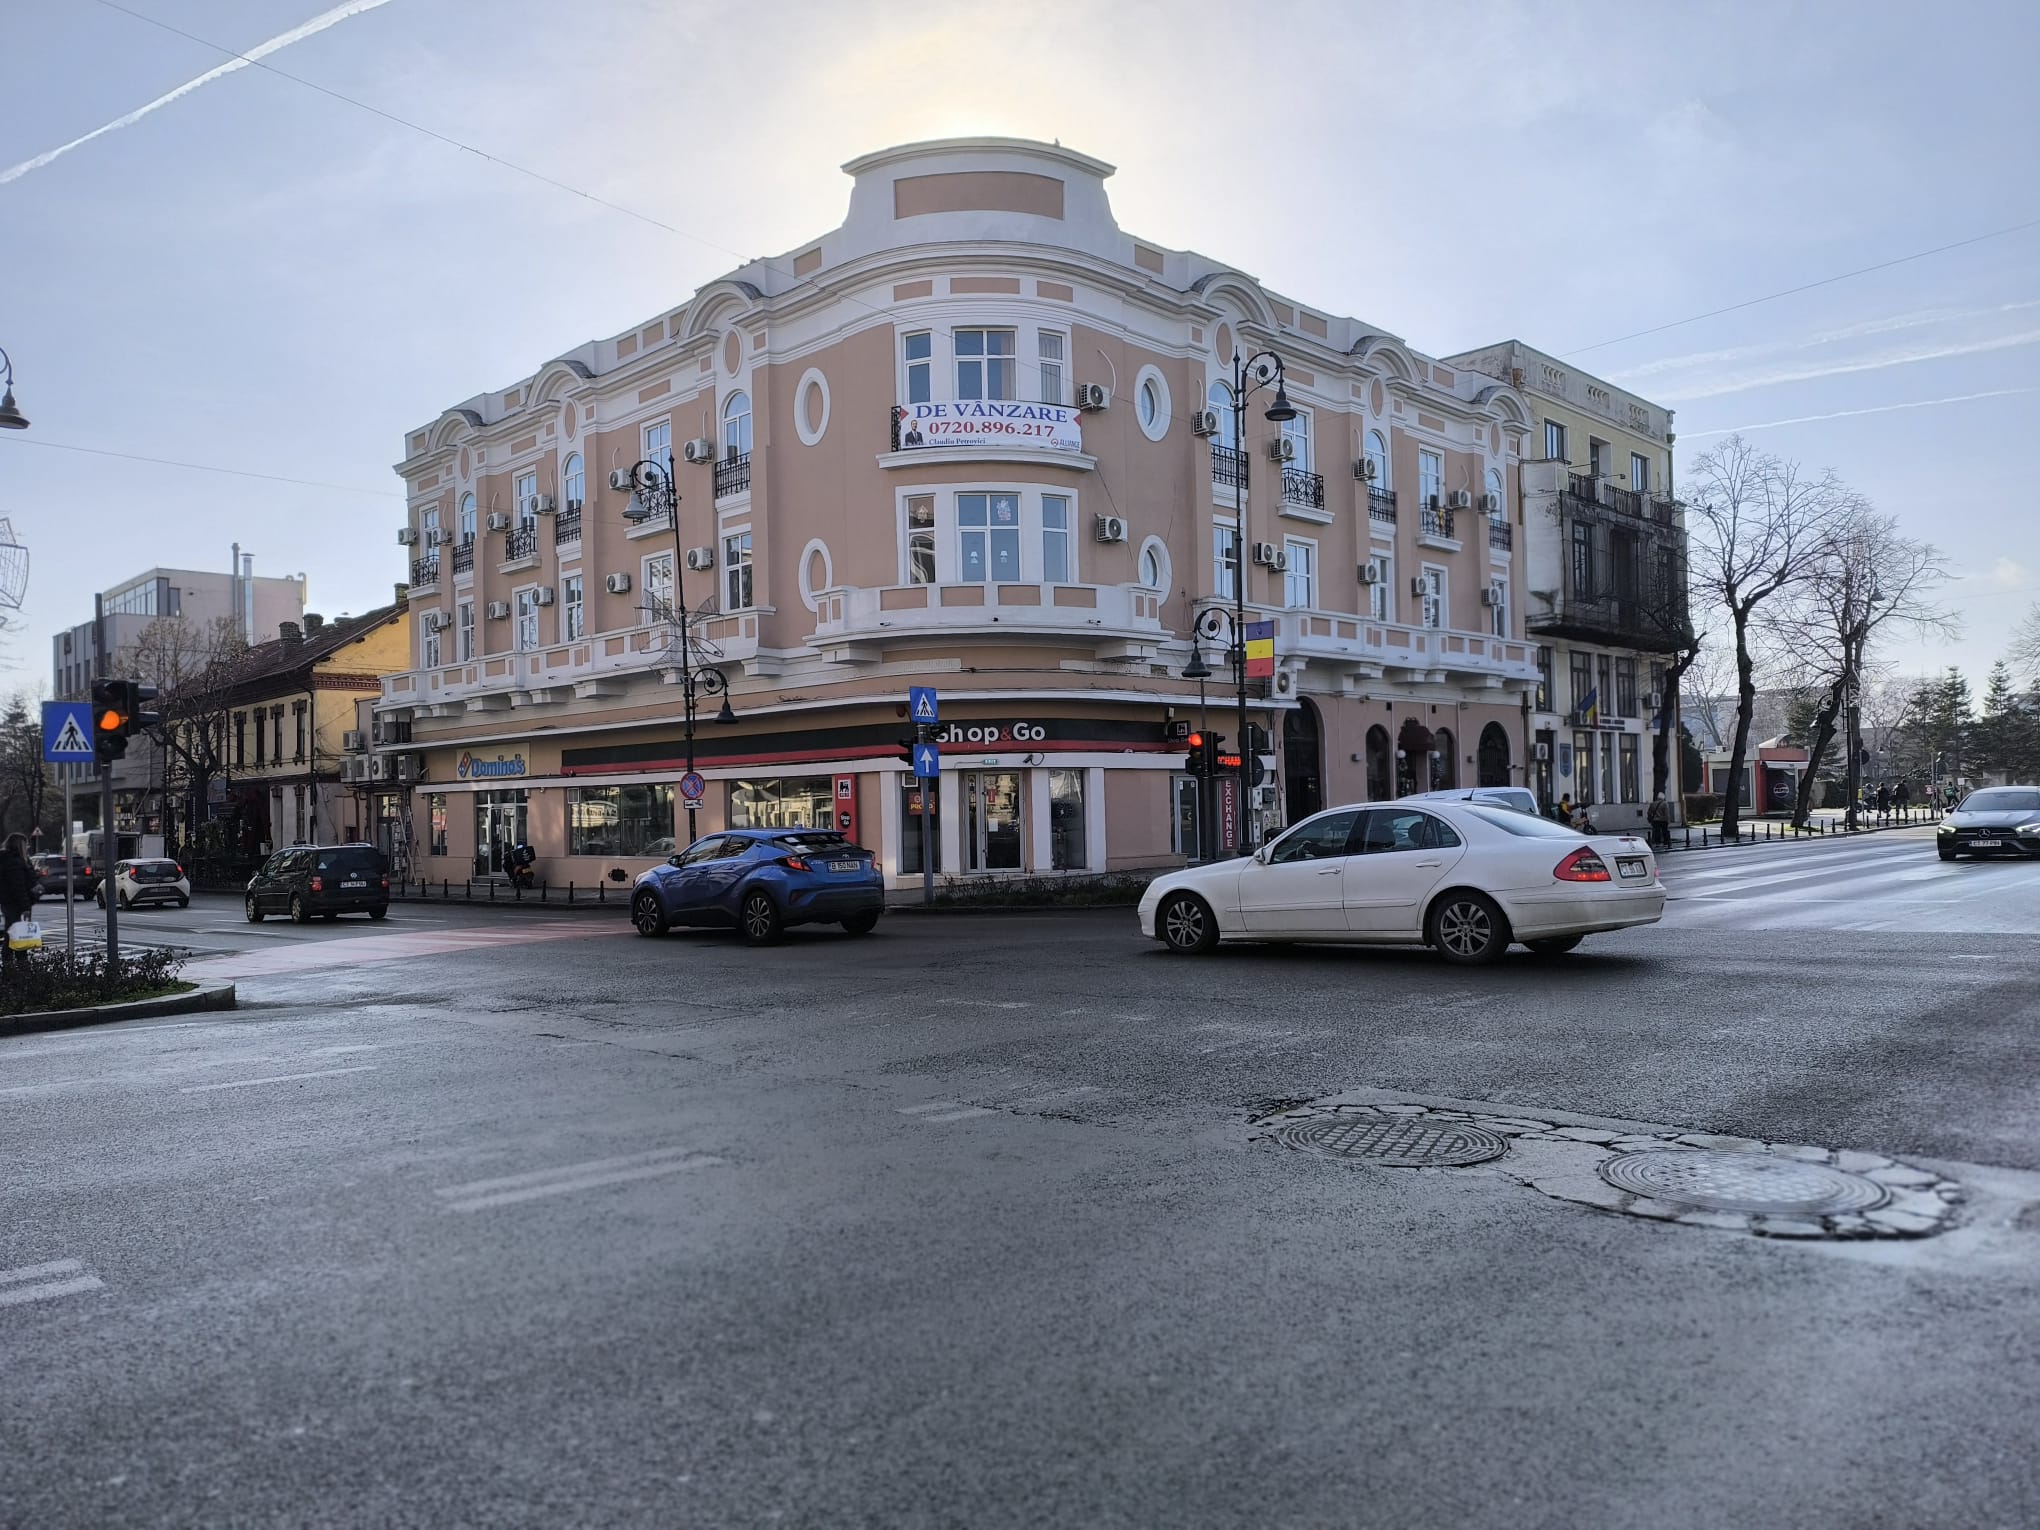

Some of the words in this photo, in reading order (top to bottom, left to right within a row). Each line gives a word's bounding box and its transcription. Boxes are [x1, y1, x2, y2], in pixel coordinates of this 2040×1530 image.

[916, 405, 947, 419] DE
[953, 401, 1068, 423] VÂNZARE
[929, 421, 1055, 437] 0720.896.217
[471, 754, 526, 778] Domino's
[1225, 780, 1233, 847] EXCHANGE
